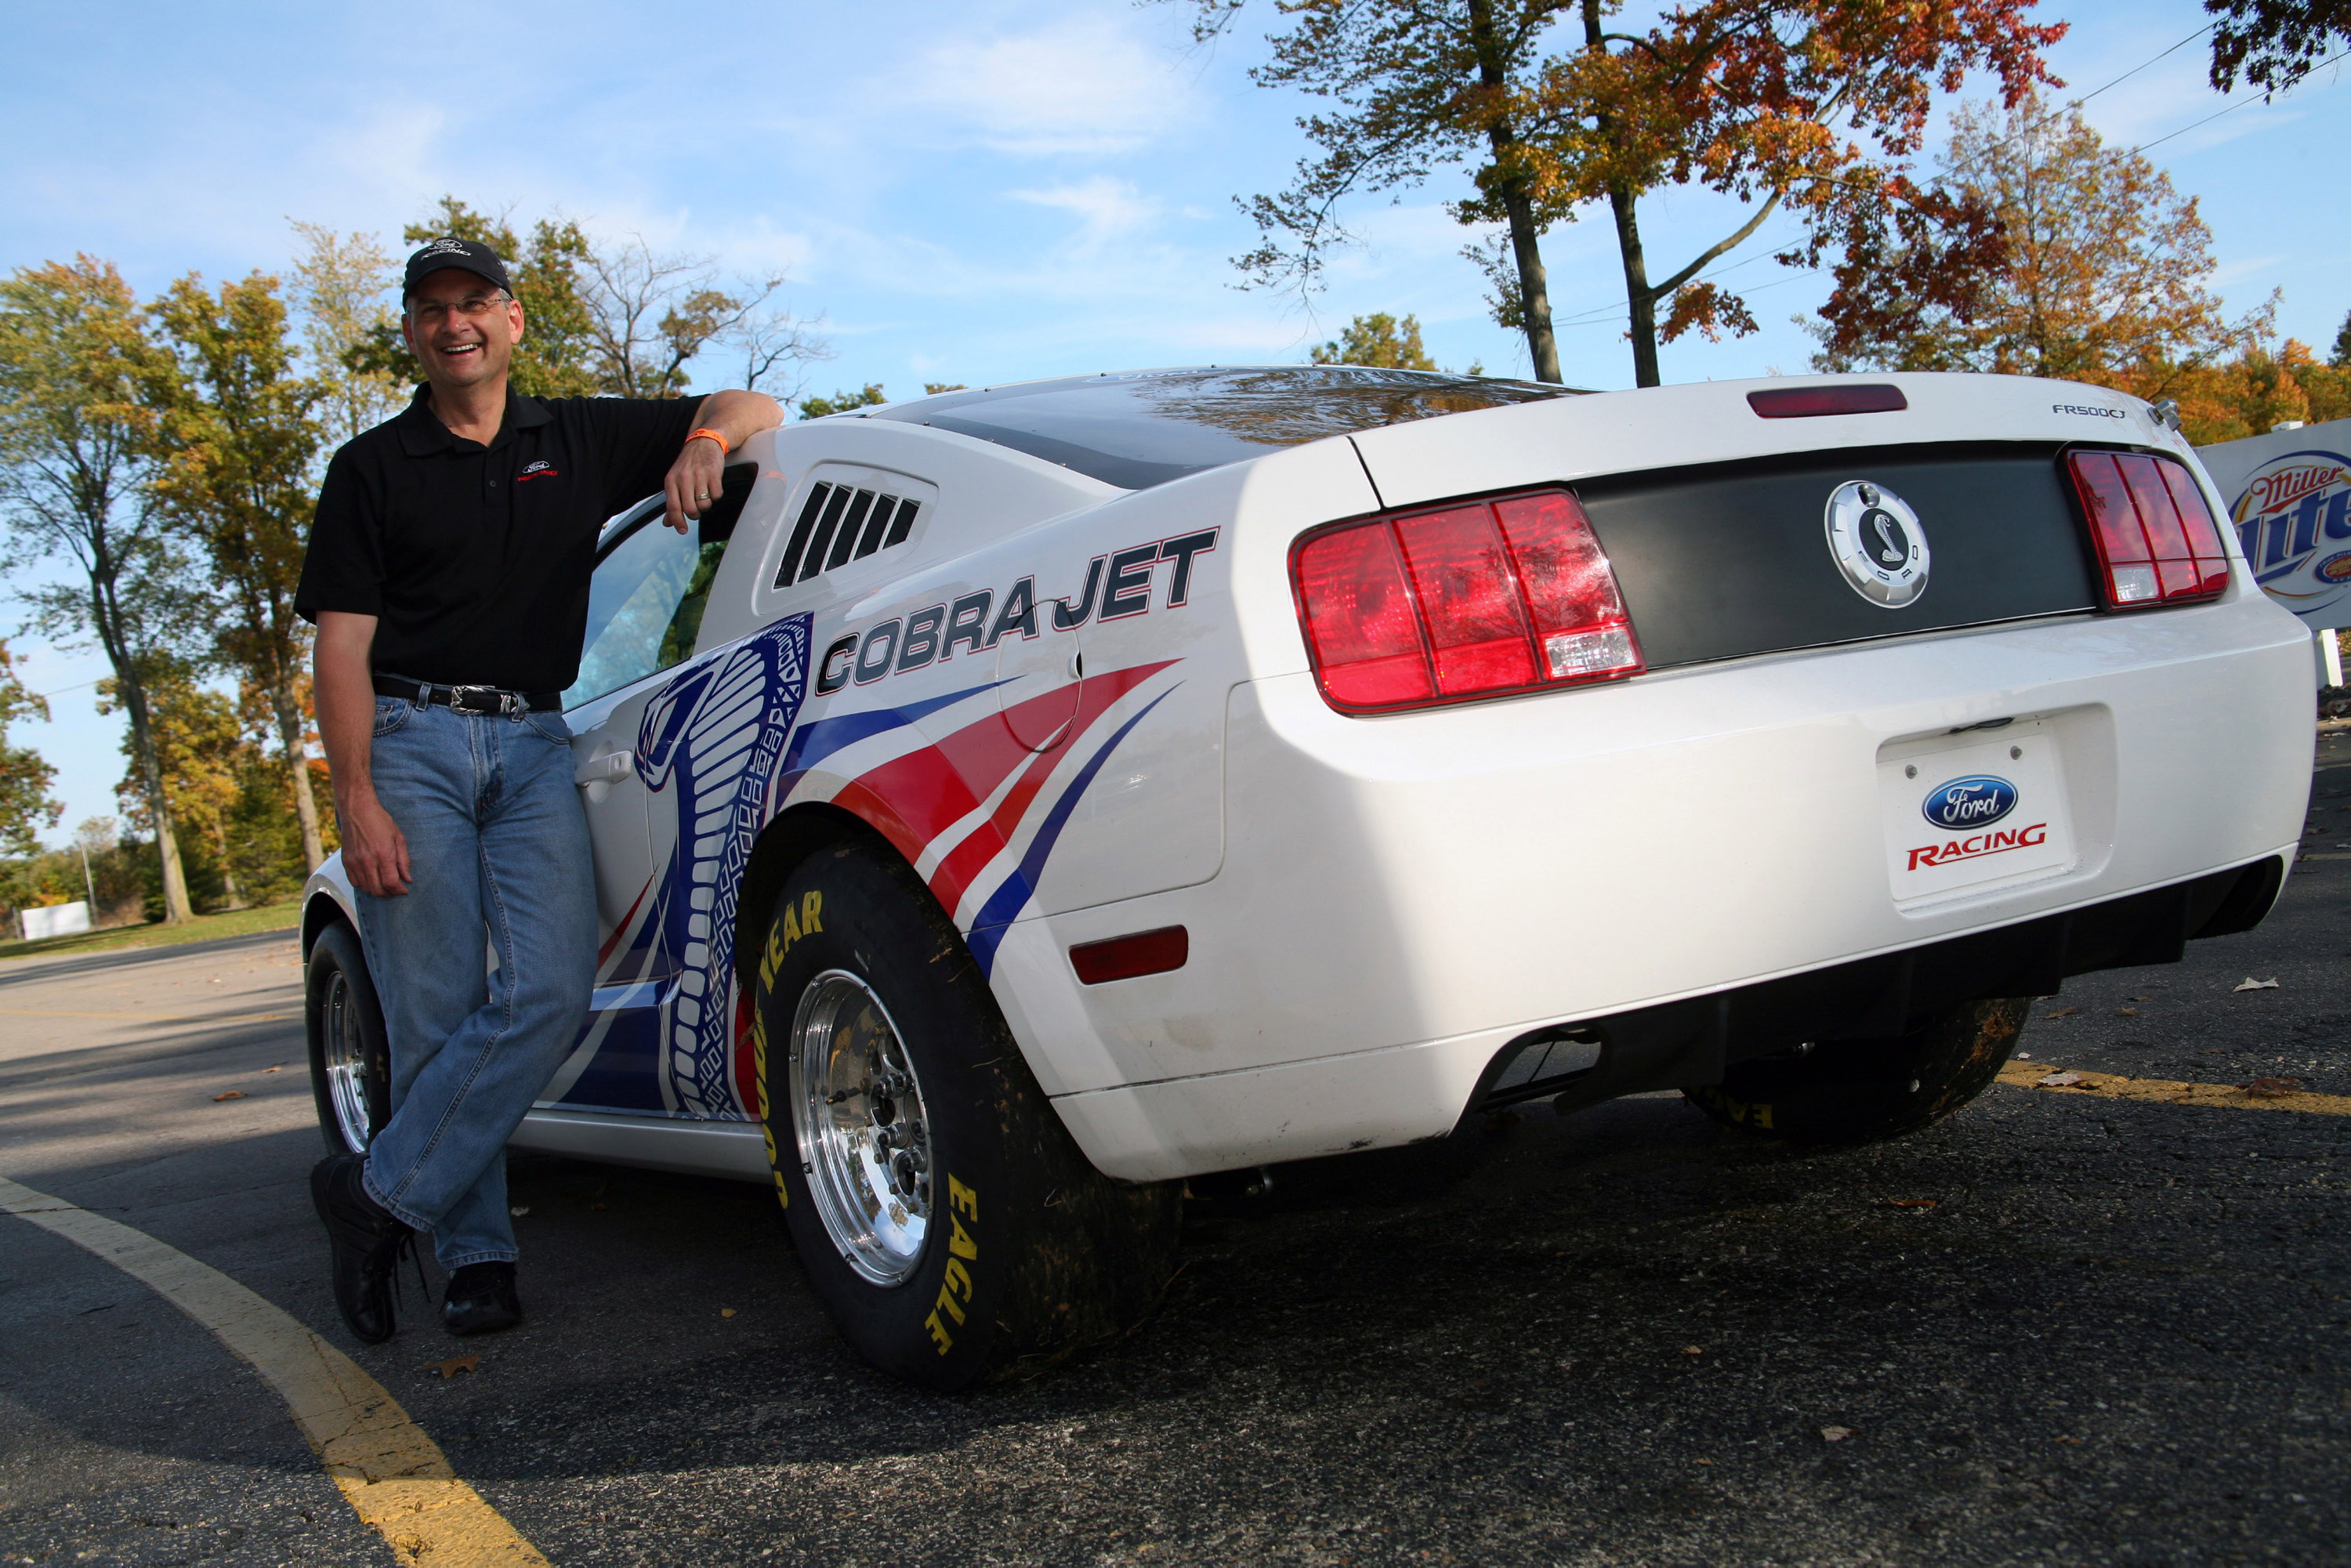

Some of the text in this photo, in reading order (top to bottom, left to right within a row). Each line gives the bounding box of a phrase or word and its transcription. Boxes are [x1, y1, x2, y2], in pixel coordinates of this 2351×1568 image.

[2052, 404, 2126, 419] FR500CJ
[2250, 466, 2346, 509] Miller
[2239, 487, 2351, 581] Lite
[814, 525, 1222, 697] COBRA JET
[1943, 784, 2000, 823] Ford
[1906, 823, 2047, 871] RACING
[924, 1171, 979, 1356] EAGLE
